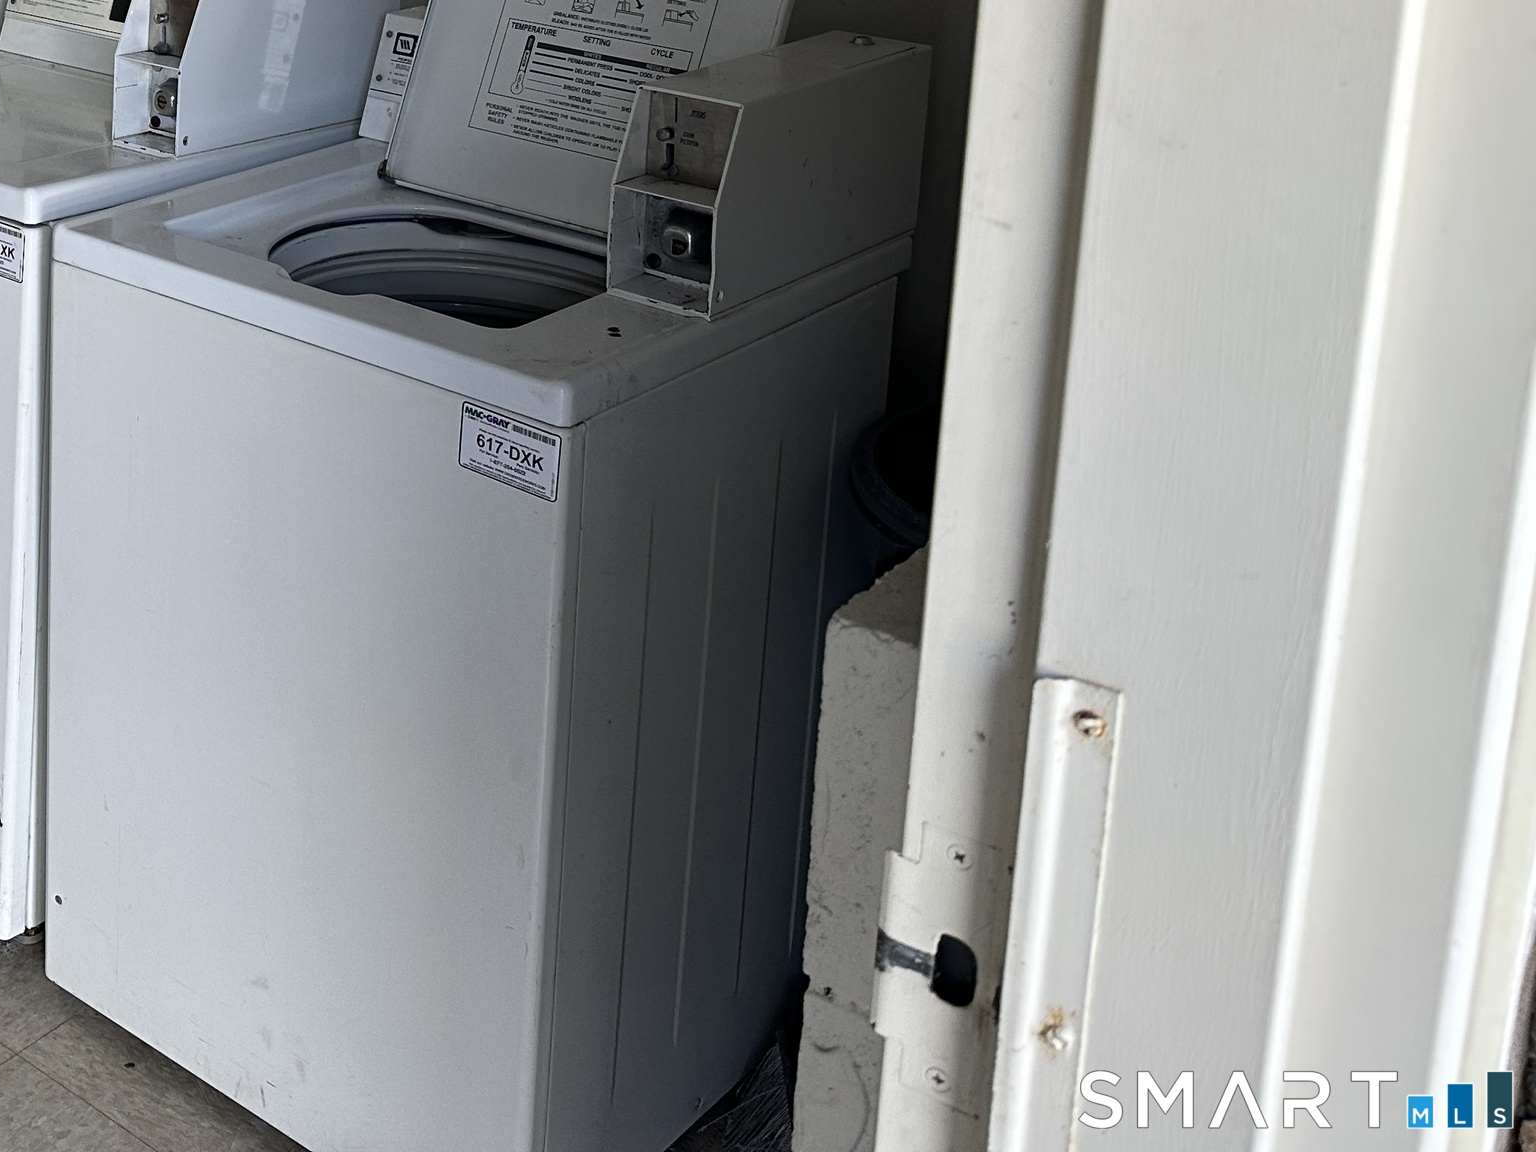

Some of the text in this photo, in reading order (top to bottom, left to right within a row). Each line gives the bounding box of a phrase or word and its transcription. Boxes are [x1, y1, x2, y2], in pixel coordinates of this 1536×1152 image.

[511, 22, 675, 59] TEMPERATURE SETTING CYCLE
[567, 56, 613, 71] PERMANENT PRESS
[646, 64, 670, 73] REGULAR
[574, 68, 600, 78] DELICATES
[574, 78, 595, 86] COLORS
[562, 84, 602, 98] BRIGHT COLORS
[486, 102, 513, 113] PERSONAL
[620, 106, 632, 114] SHO
[488, 110, 508, 118] SAFETY
[488, 116, 504, 124] RULES
[464, 406, 510, 429] MAC-GRAY
[476, 434, 544, 472] 617-DXK
